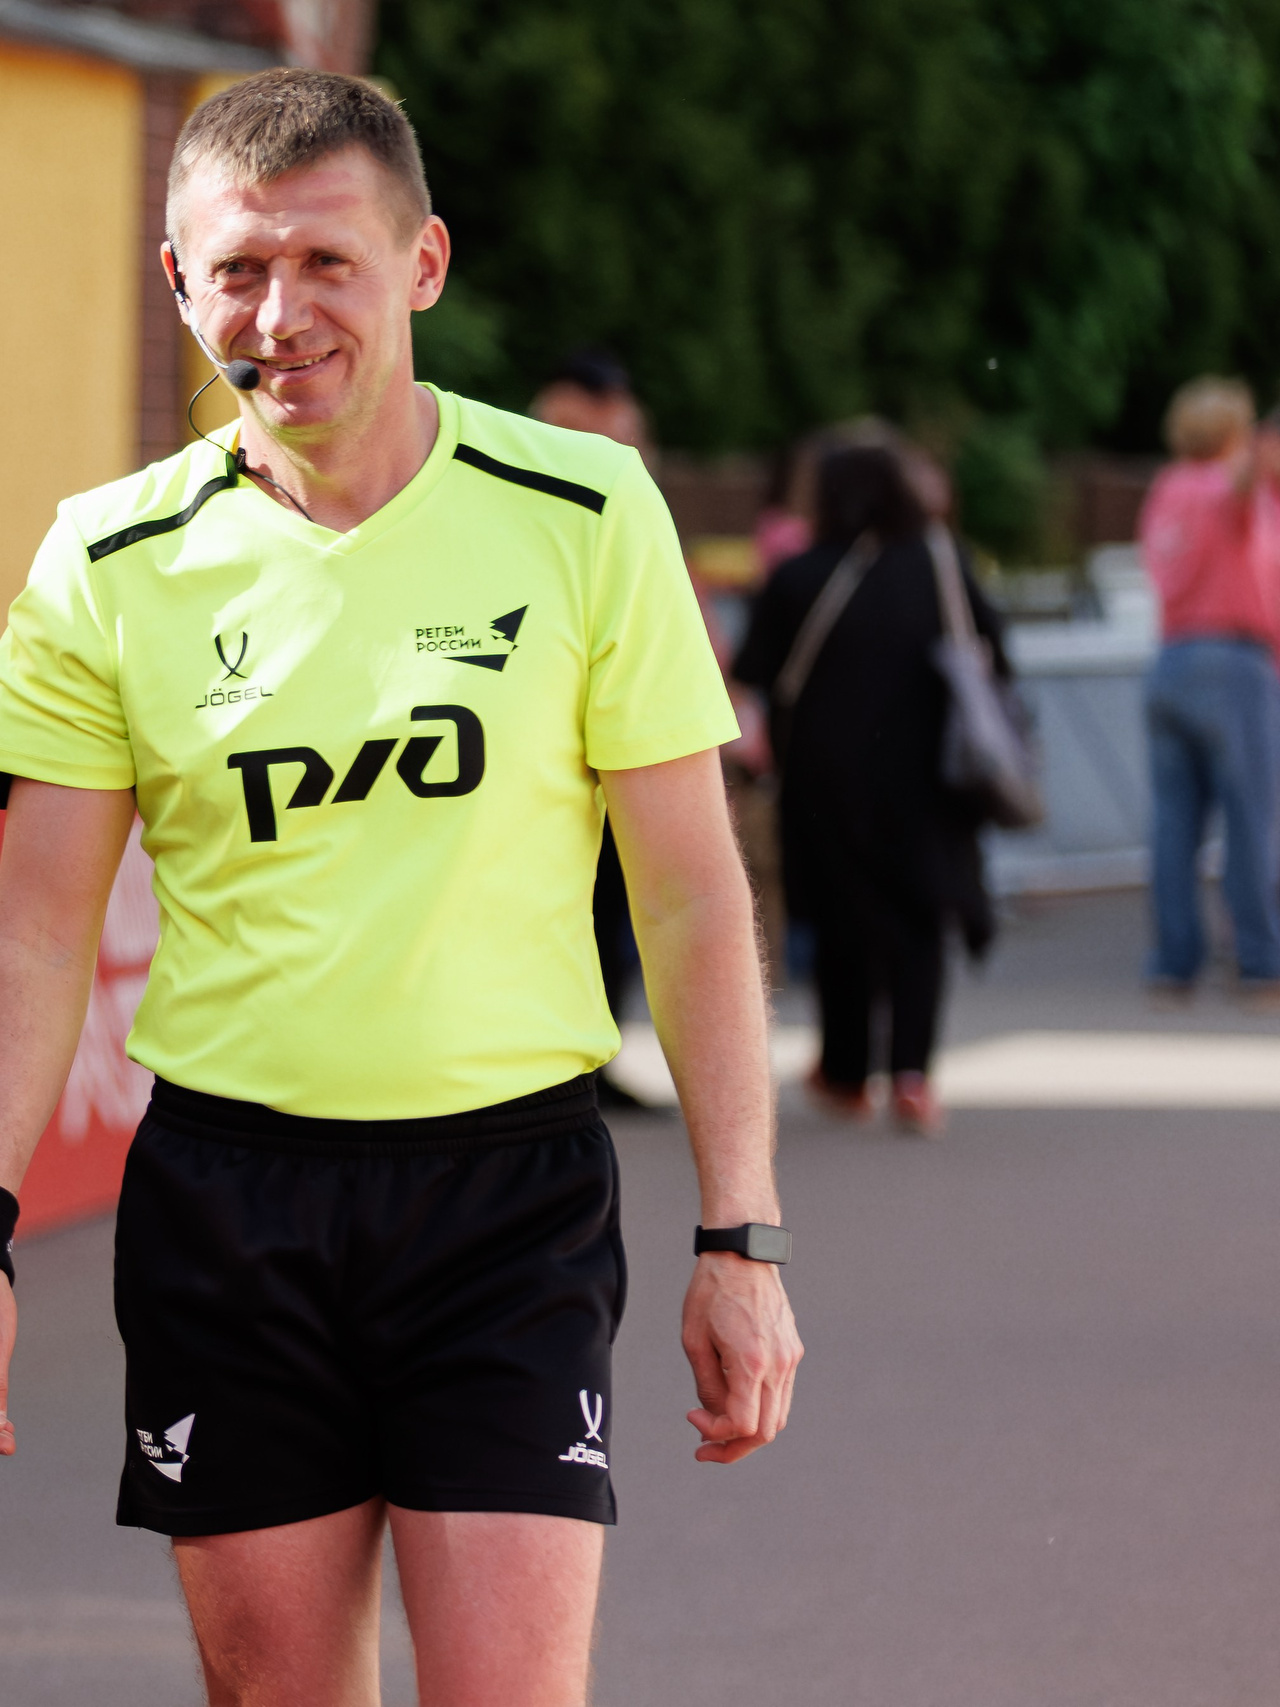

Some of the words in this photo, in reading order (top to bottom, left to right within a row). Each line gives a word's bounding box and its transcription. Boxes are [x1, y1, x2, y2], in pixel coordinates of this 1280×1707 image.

[415, 626, 465, 639] РЕГБИ
[416, 638, 482, 653] РОССИИ
[194, 686, 274, 709] JÖGEL
